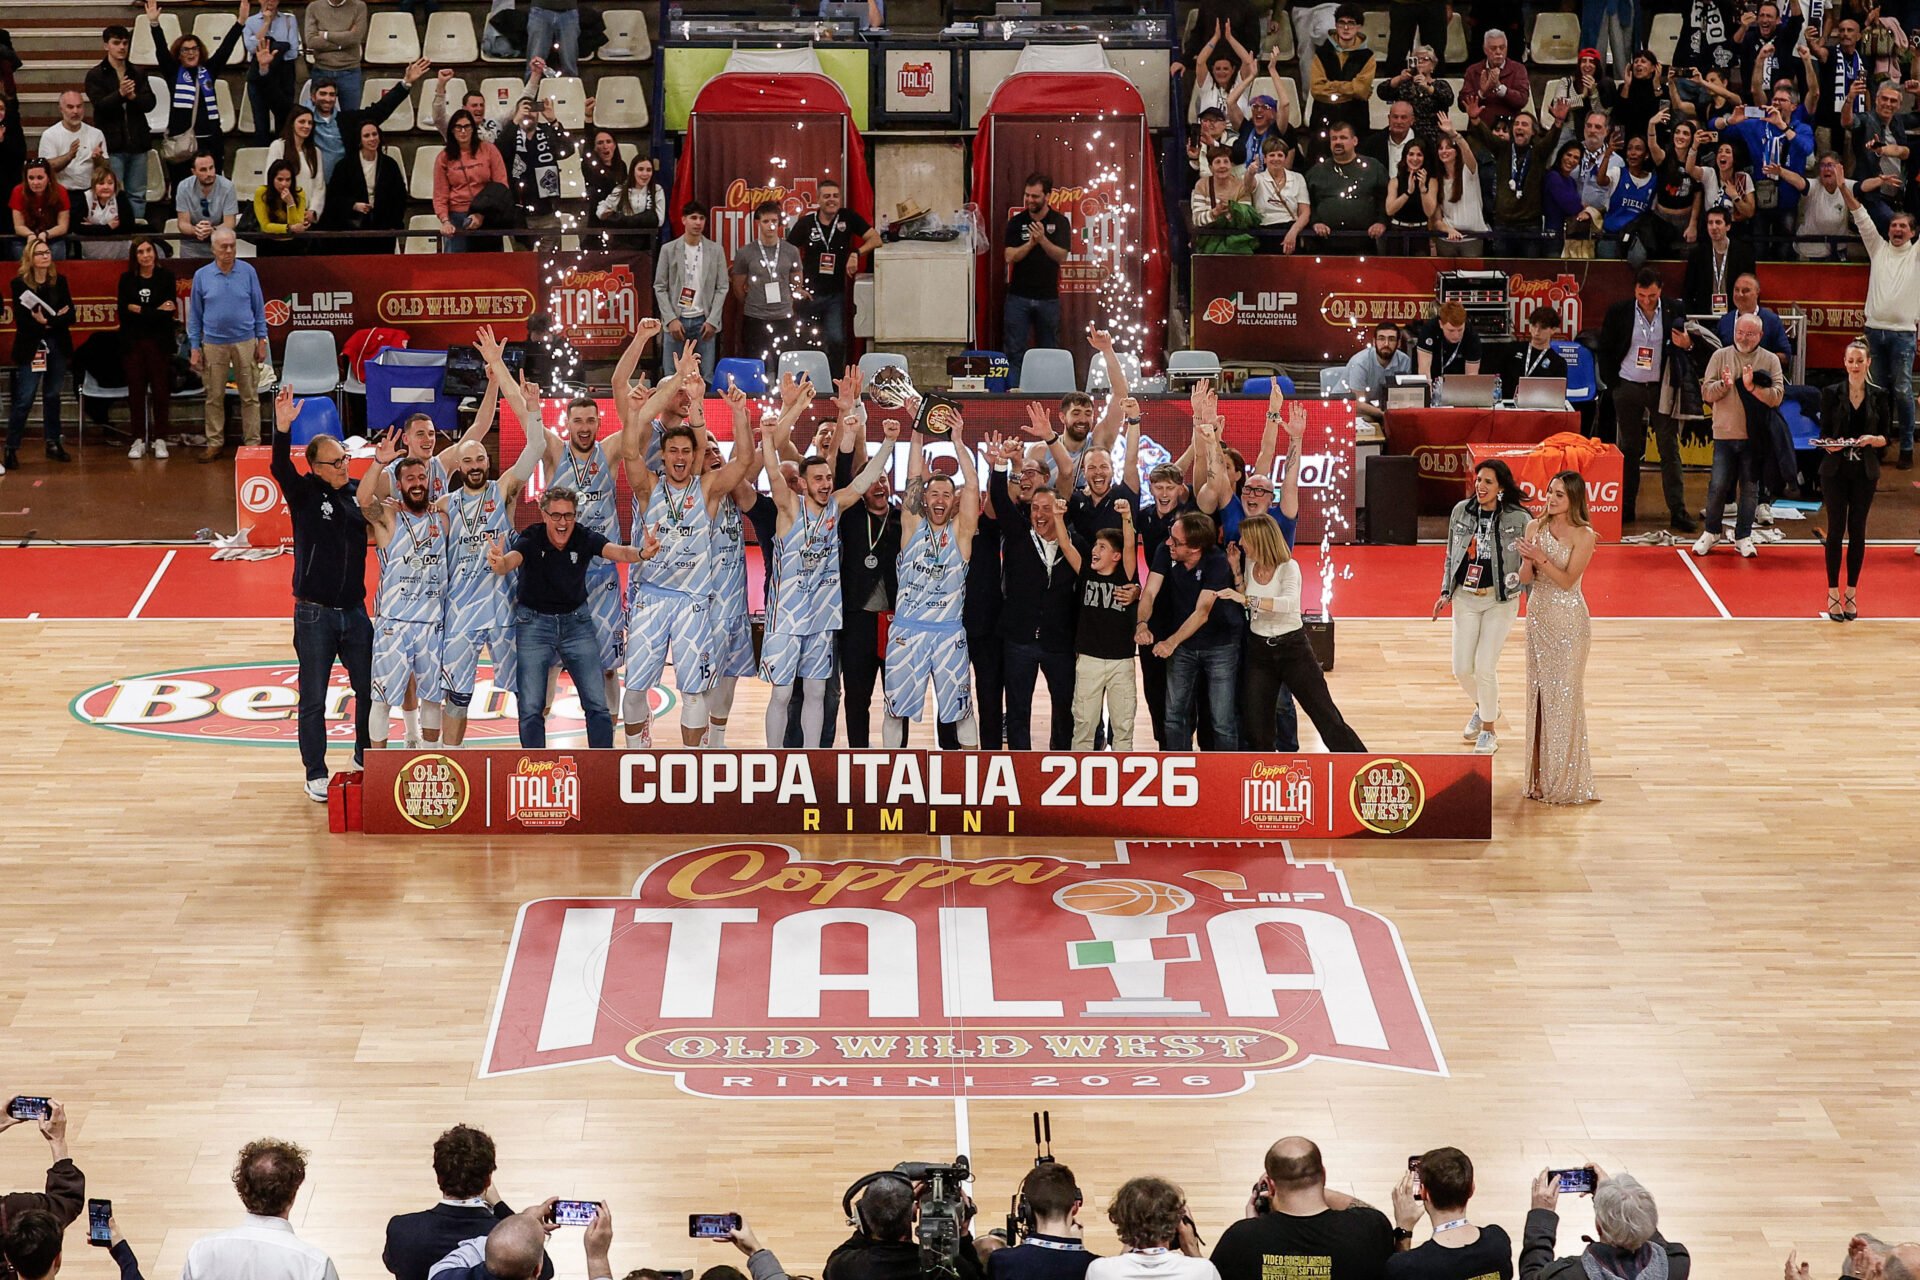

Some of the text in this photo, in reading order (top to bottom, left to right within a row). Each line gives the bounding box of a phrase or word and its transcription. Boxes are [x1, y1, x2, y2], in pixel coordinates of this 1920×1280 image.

[899, 72, 932, 91] ITALIA
[729, 182, 786, 209] Coppa
[564, 267, 606, 288] Coppa
[1509, 274, 1551, 296] Coppa
[292, 291, 352, 311] LNP
[386, 295, 527, 316] OLD WILD WEST
[1237, 291, 1298, 311] LNP
[1330, 299, 1367, 319] OLD
[1370, 300, 1417, 319] WILD
[313, 312, 353, 320] NAZIONALE
[554, 288, 636, 333] ITALIA
[1826, 309, 1865, 327] WES
[1237, 318, 1298, 326] PALLACANESTRO
[1420, 452, 1459, 473] OLD
[612, 642, 624, 658] 18
[700, 664, 711, 680] 15
[957, 695, 968, 711] 11
[413, 764, 450, 782] OLD
[519, 757, 554, 775] Coppa
[1252, 761, 1288, 779] Coppa
[619, 753, 1198, 807] COPPA ITALIA 2026
[1367, 768, 1406, 786] OLD
[408, 781, 455, 799] WILD
[510, 775, 578, 816] ITALIA
[1363, 786, 1411, 804] WILD
[405, 798, 458, 816] WEST
[1244, 779, 1312, 820] ITALIA
[803, 808, 1016, 833] RIMINI
[1360, 803, 1413, 821] WEST
[667, 850, 1069, 904] Coppa
[1222, 892, 1325, 903] LNP
[537, 907, 1391, 1050] ITALIA
[666, 1034, 1260, 1059] OLD WILD WEST
[721, 1075, 1212, 1087] RIMINI 2026
[1263, 1254, 1284, 1266] VIDEO
[1298, 1266, 1332, 1276] SOFTWARE
